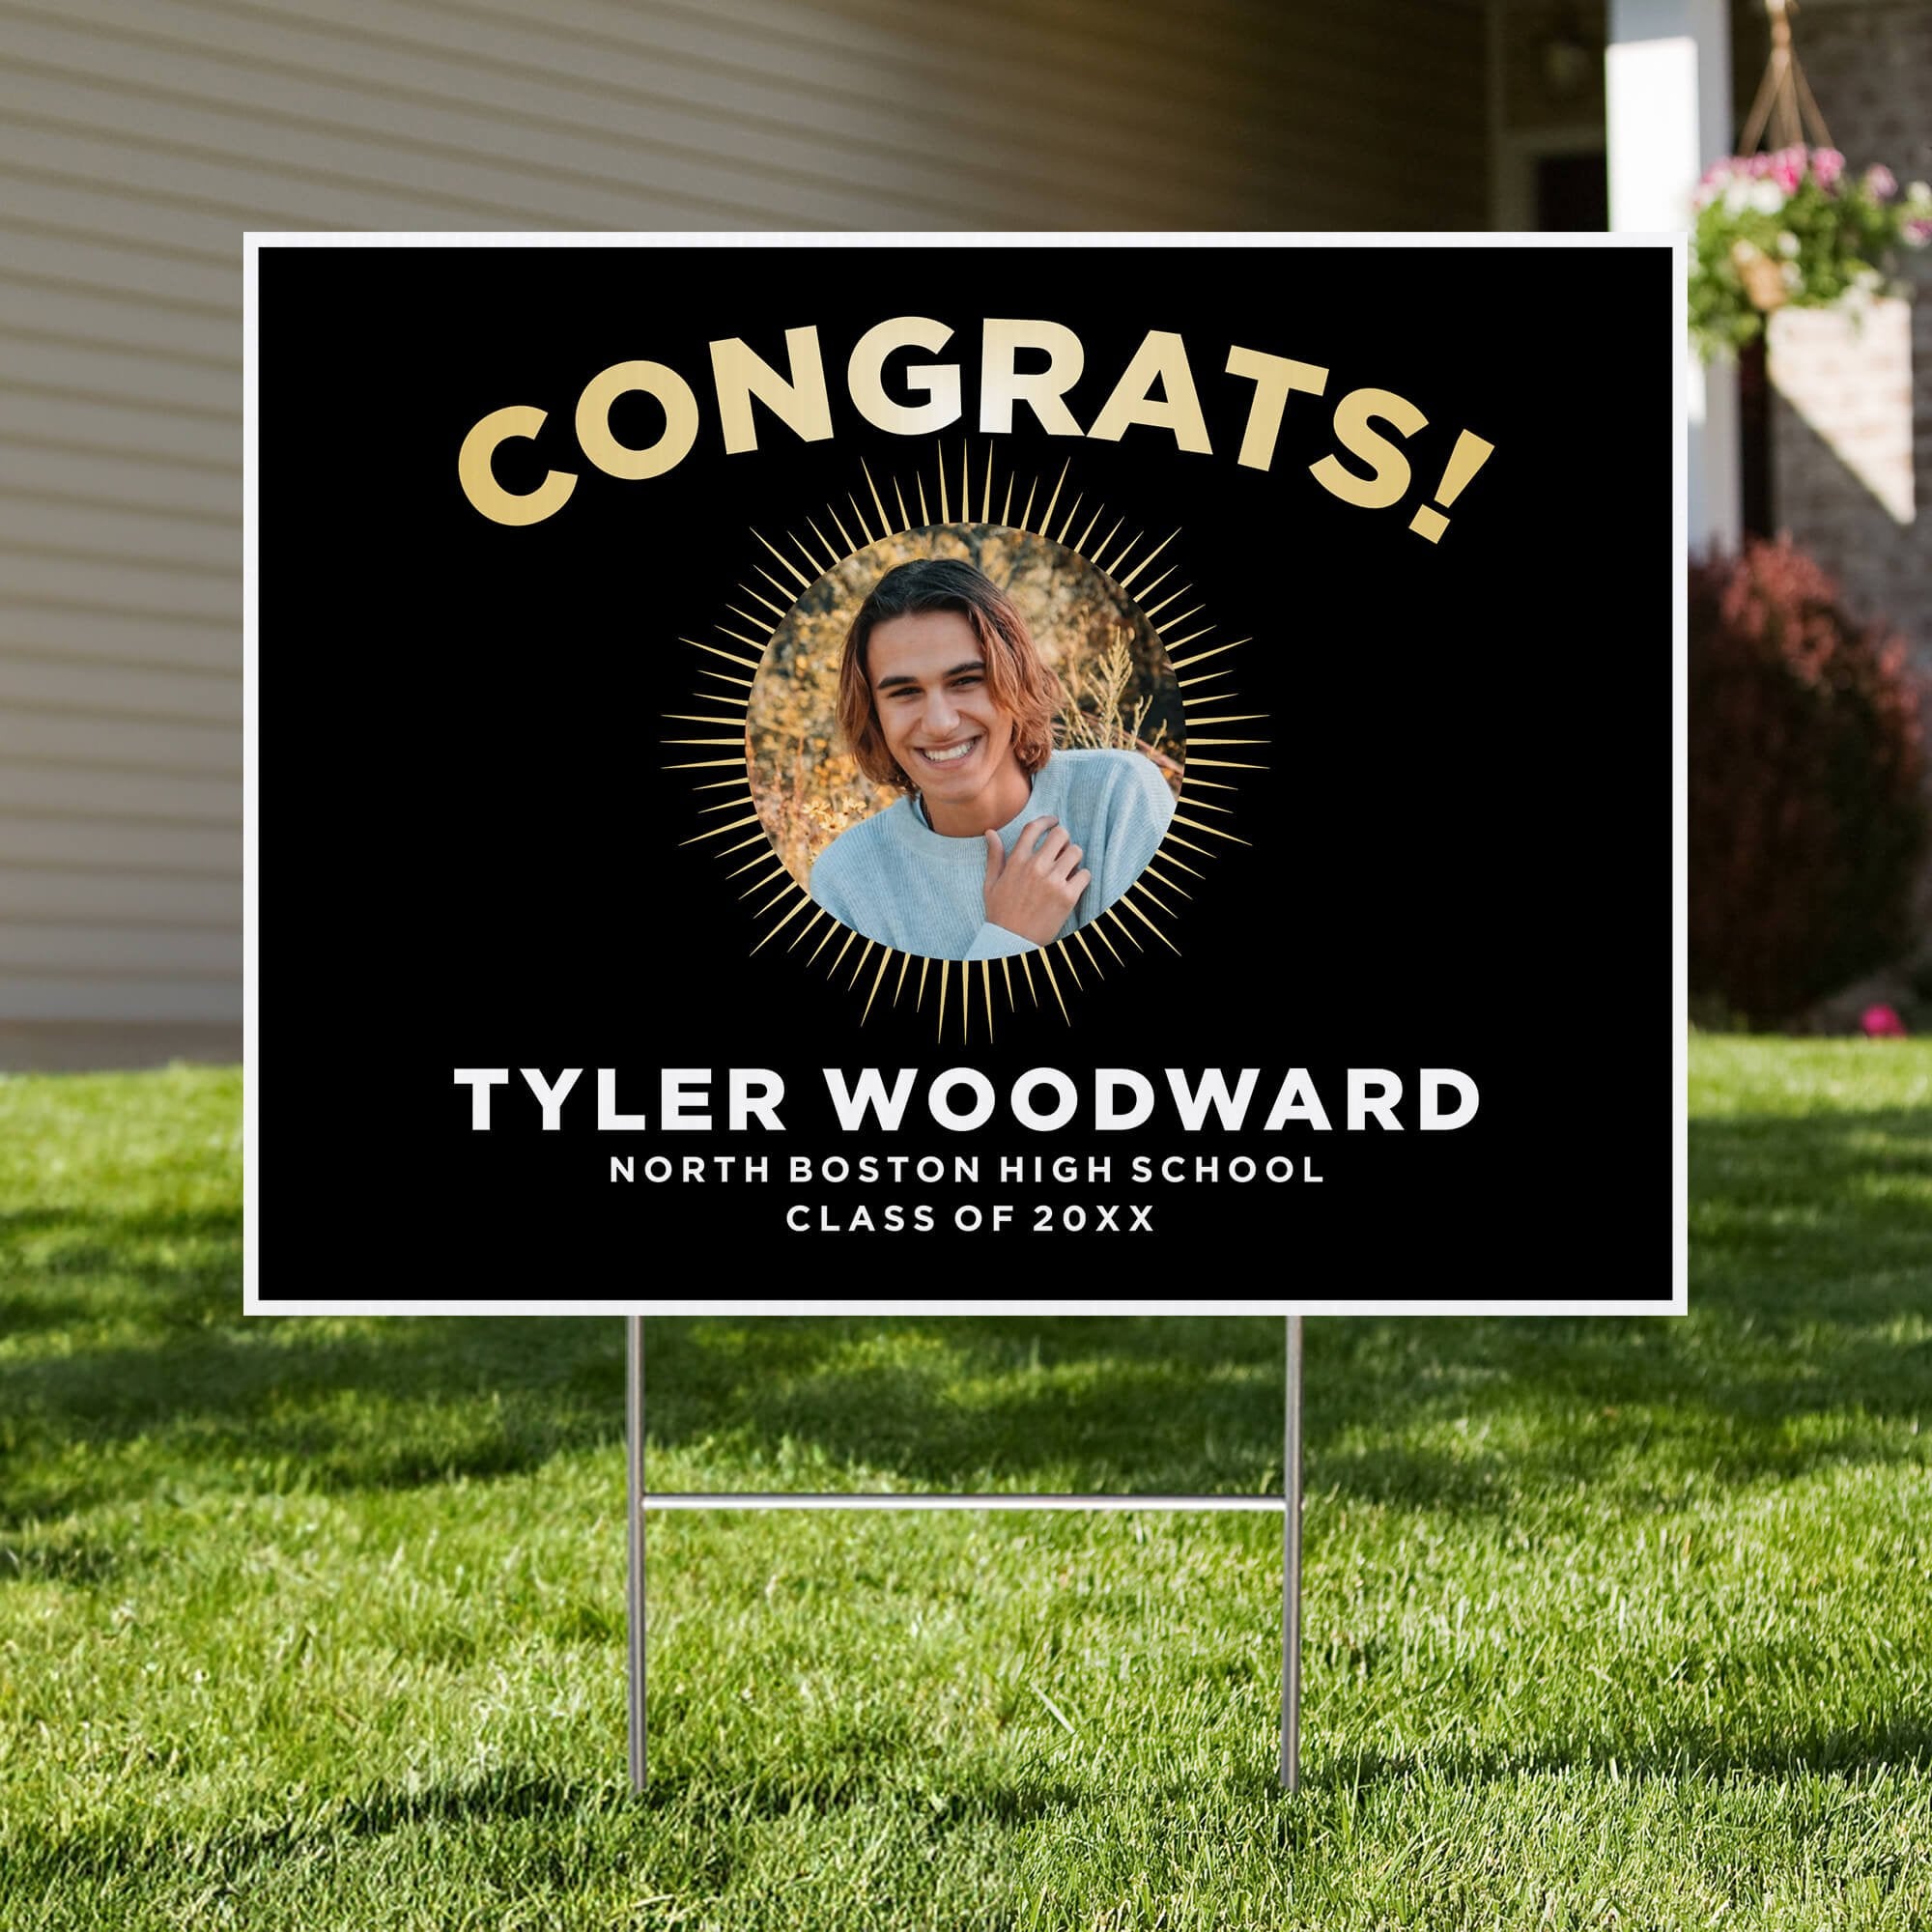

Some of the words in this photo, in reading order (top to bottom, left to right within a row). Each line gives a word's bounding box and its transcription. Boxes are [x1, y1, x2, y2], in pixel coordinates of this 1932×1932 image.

[459, 317, 1494, 544] CONGRATS!
[454, 1067, 785, 1131] TYLER
[823, 1067, 1479, 1131] WOODWARD
[611, 1156, 767, 1182] NORTH
[790, 1156, 978, 1182] BOSTON
[1001, 1156, 1110, 1182] HIGH
[1132, 1156, 1322, 1182] SCHOOL
[787, 1206, 934, 1232] CLASS
[955, 1206, 1013, 1232] OF
[1034, 1206, 1152, 1232] 20XX
